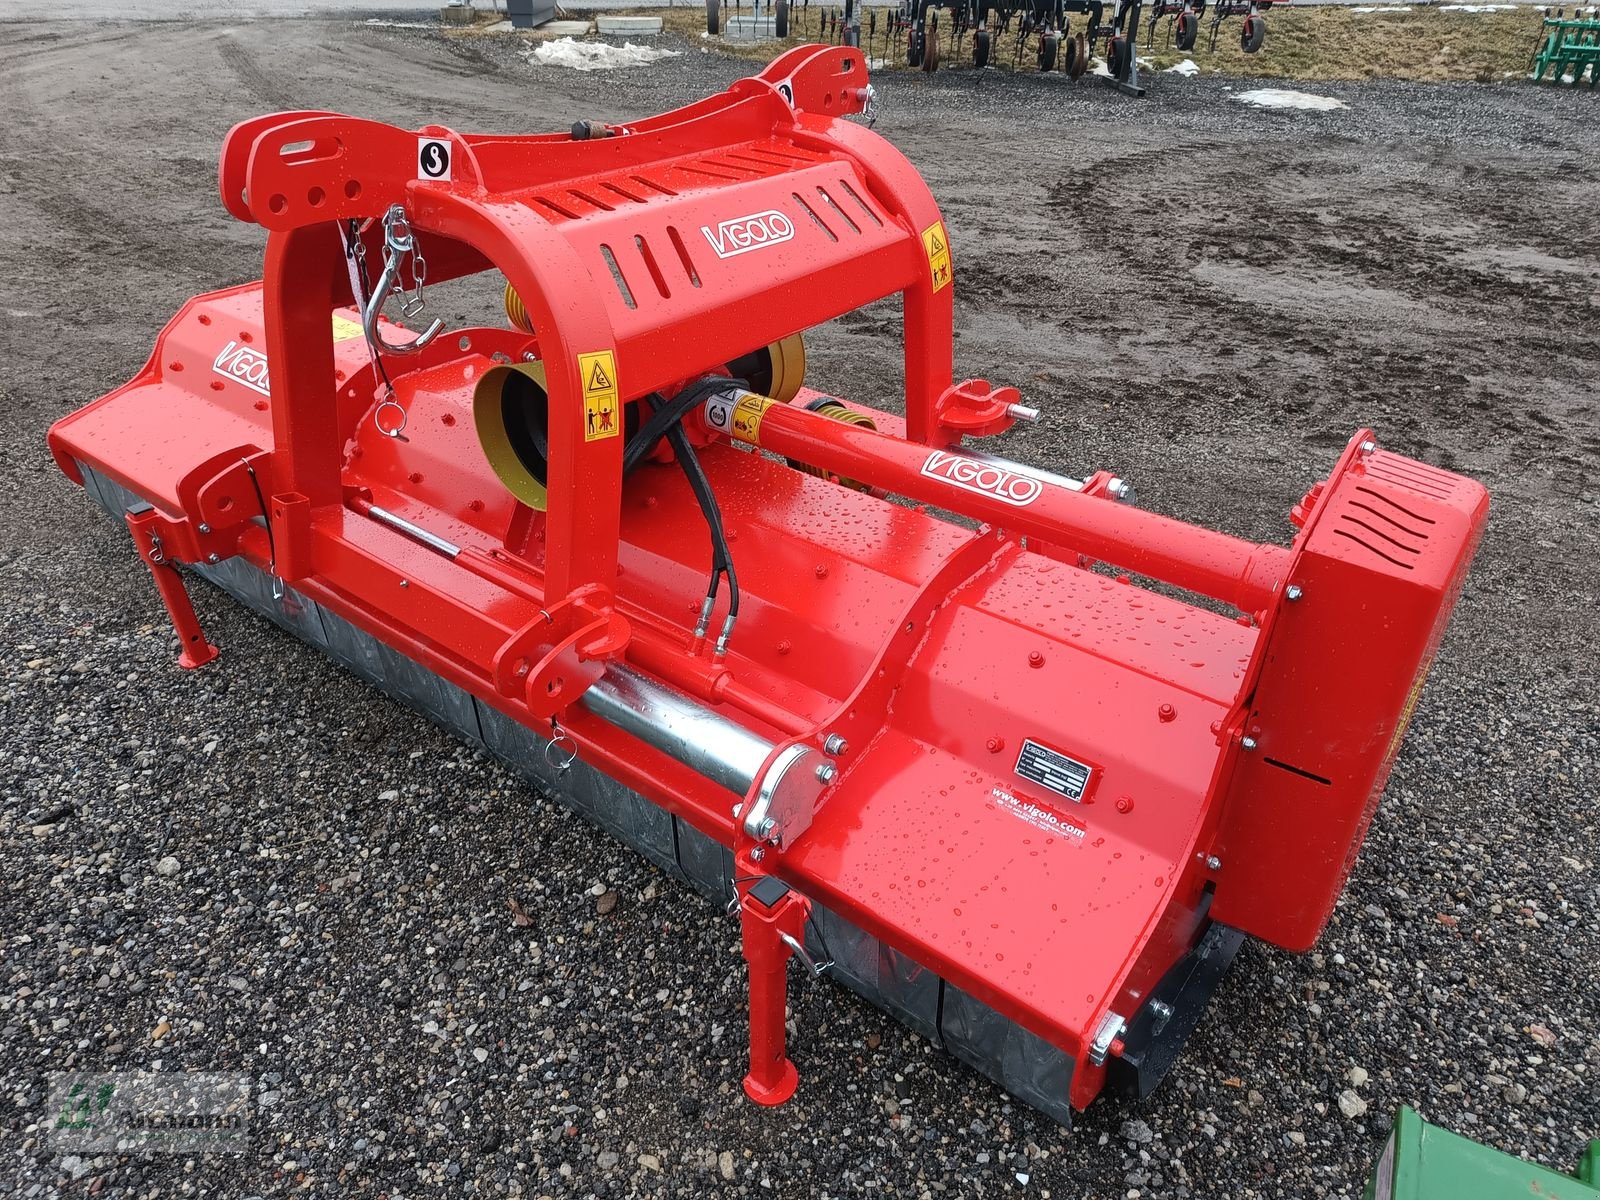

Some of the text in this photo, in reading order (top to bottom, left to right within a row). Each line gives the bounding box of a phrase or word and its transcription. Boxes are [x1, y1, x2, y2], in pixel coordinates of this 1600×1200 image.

[700, 210, 795, 259] VIGOLO
[212, 340, 271, 398] VIGOL
[920, 450, 1043, 506] VIGOLO
[992, 788, 1086, 838] www.vigolo.com
